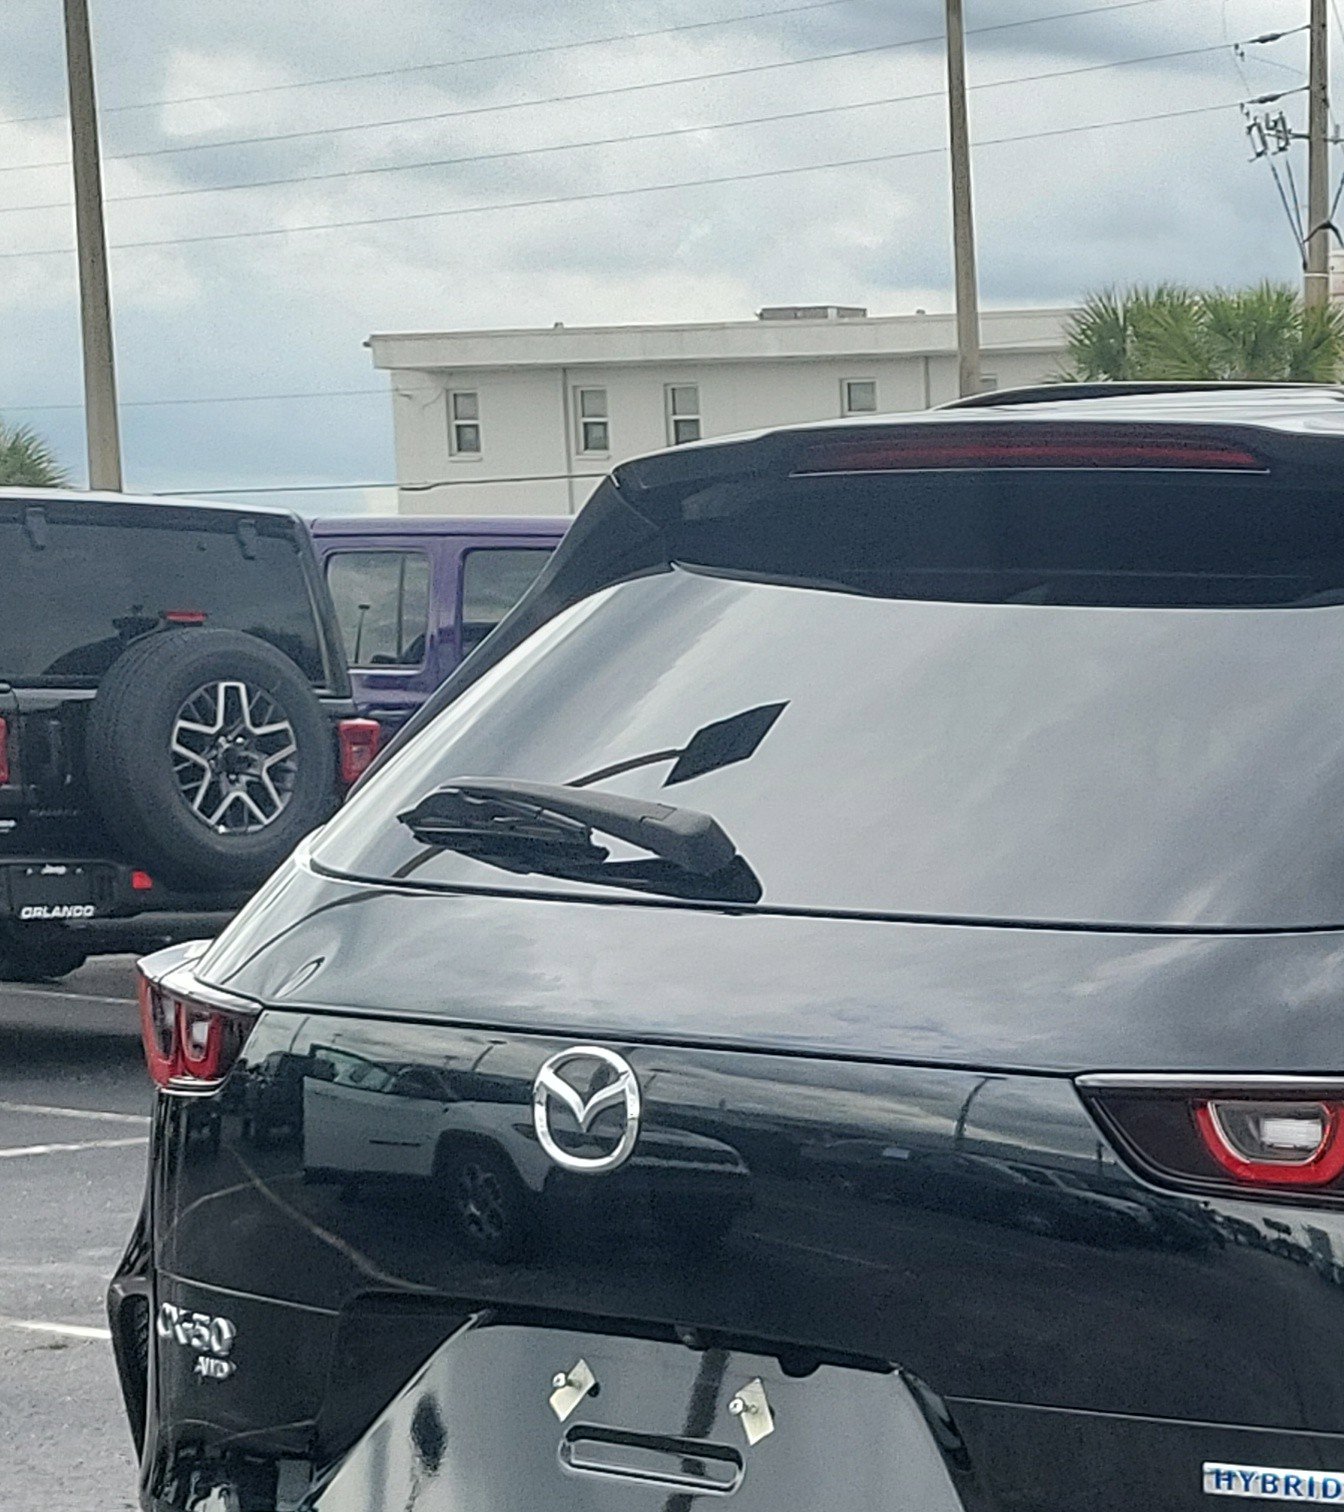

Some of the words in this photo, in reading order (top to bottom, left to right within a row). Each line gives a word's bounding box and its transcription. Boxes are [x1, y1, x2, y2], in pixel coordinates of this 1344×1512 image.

[20, 905, 95, 919] ORLANDO
[157, 1302, 237, 1356] CX-50
[1214, 1468, 1342, 1499] HYBRID
